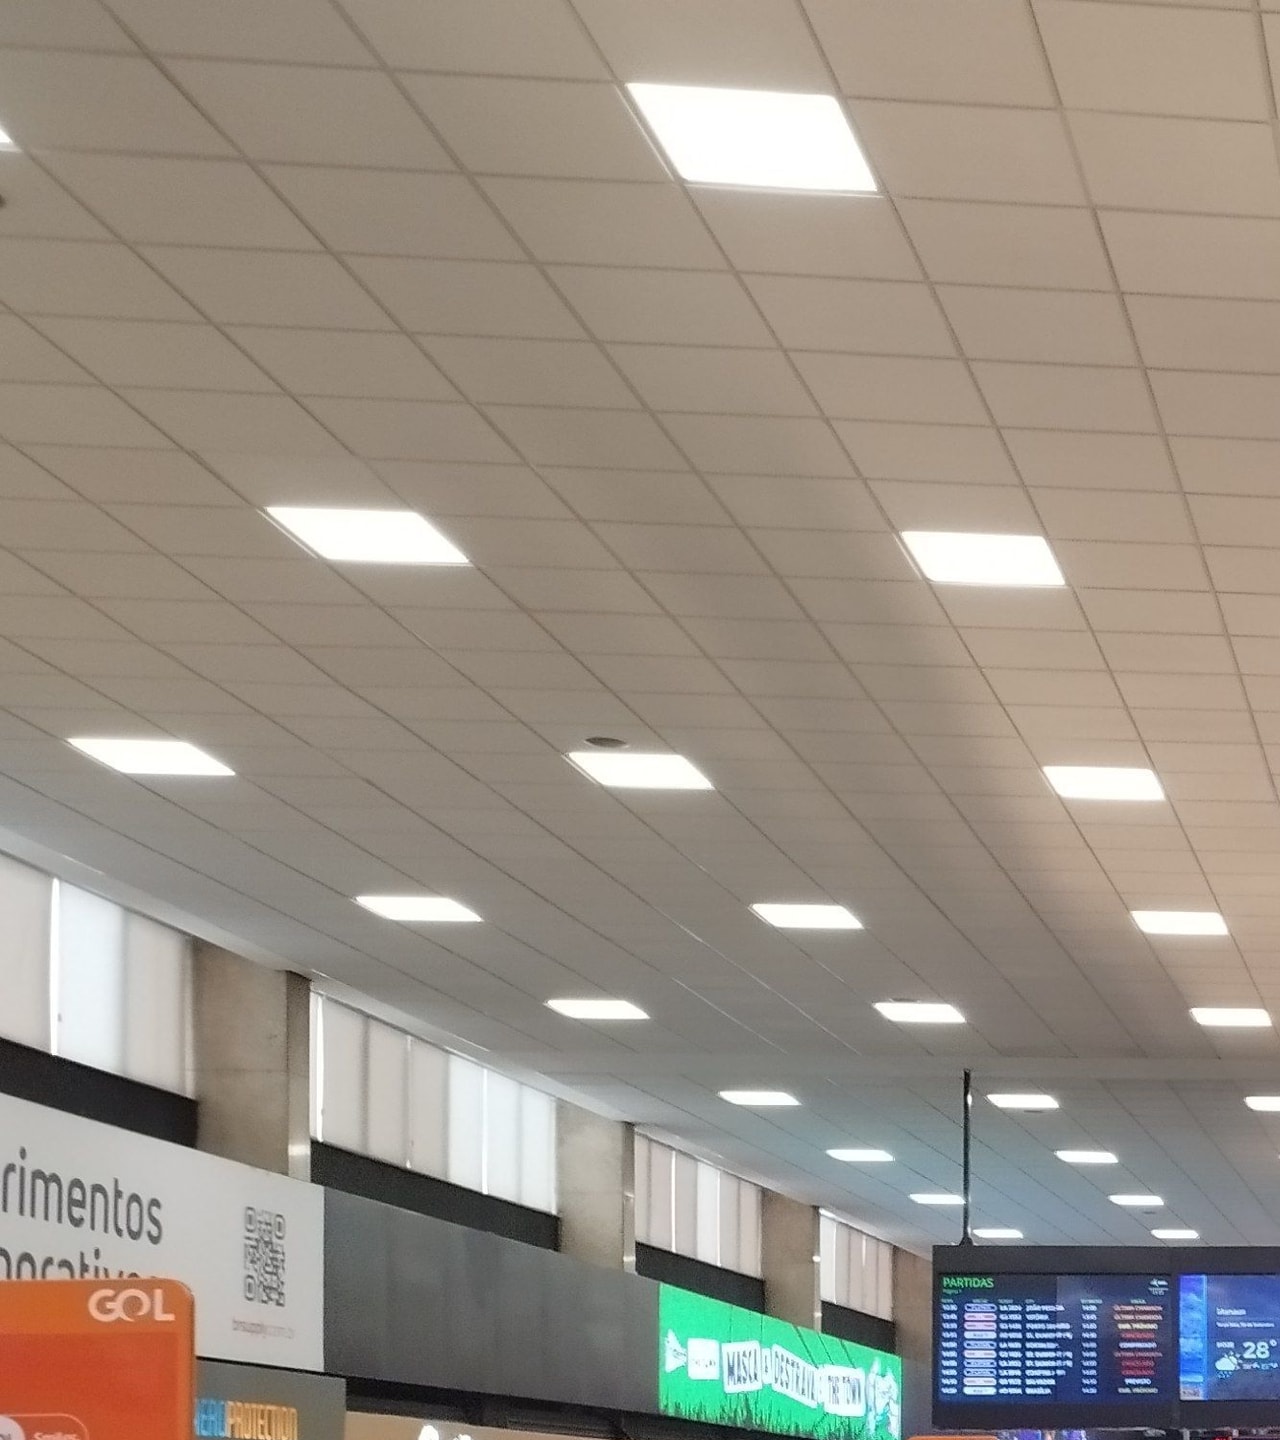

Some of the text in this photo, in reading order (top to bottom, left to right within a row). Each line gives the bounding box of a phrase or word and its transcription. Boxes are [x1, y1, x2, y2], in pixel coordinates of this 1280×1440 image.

[2, 1146, 163, 1245] rimentos
[943, 1277, 995, 1288] PARTIDAS
[88, 1289, 176, 1322] GOL
